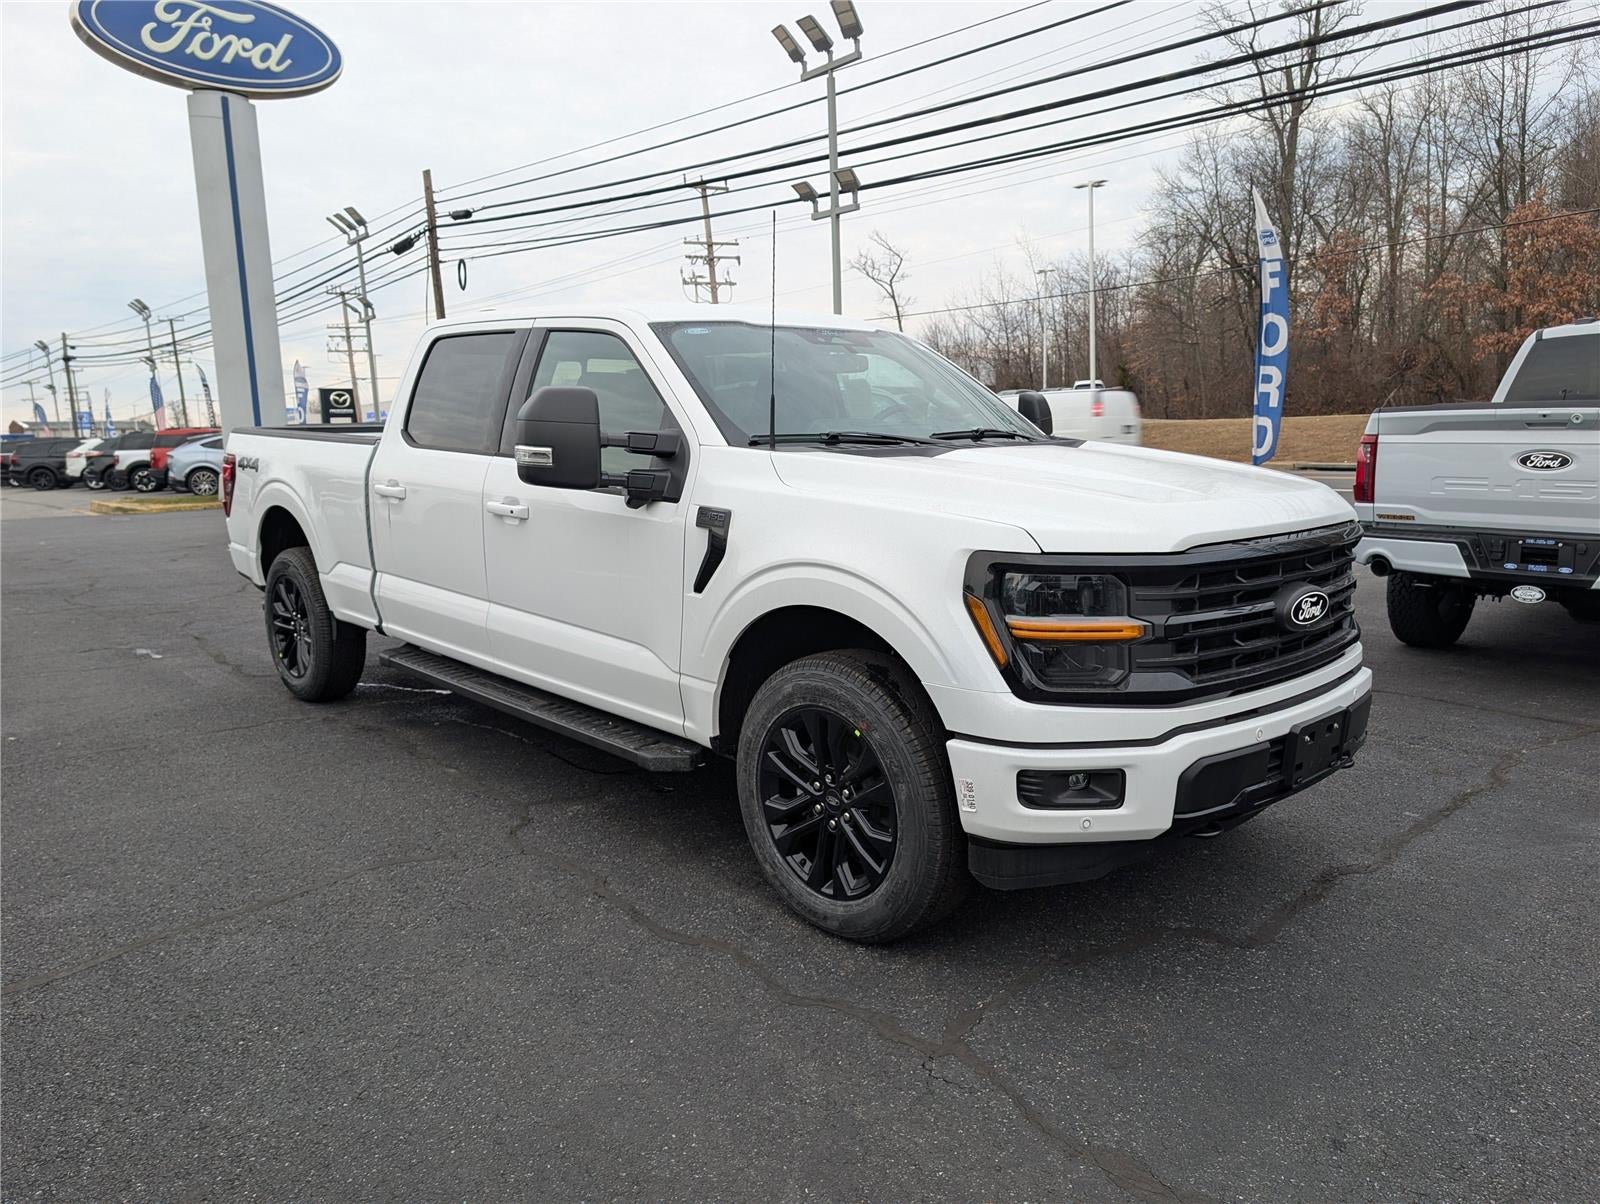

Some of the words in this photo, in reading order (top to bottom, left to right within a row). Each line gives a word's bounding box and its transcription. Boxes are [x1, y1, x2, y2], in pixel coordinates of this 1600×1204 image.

[140, 0, 293, 73] Ford
[1252, 261, 1288, 457] FORD
[1526, 454, 1561, 467] Ford
[700, 510, 725, 521] 150
[1299, 596, 1323, 620] Ford
